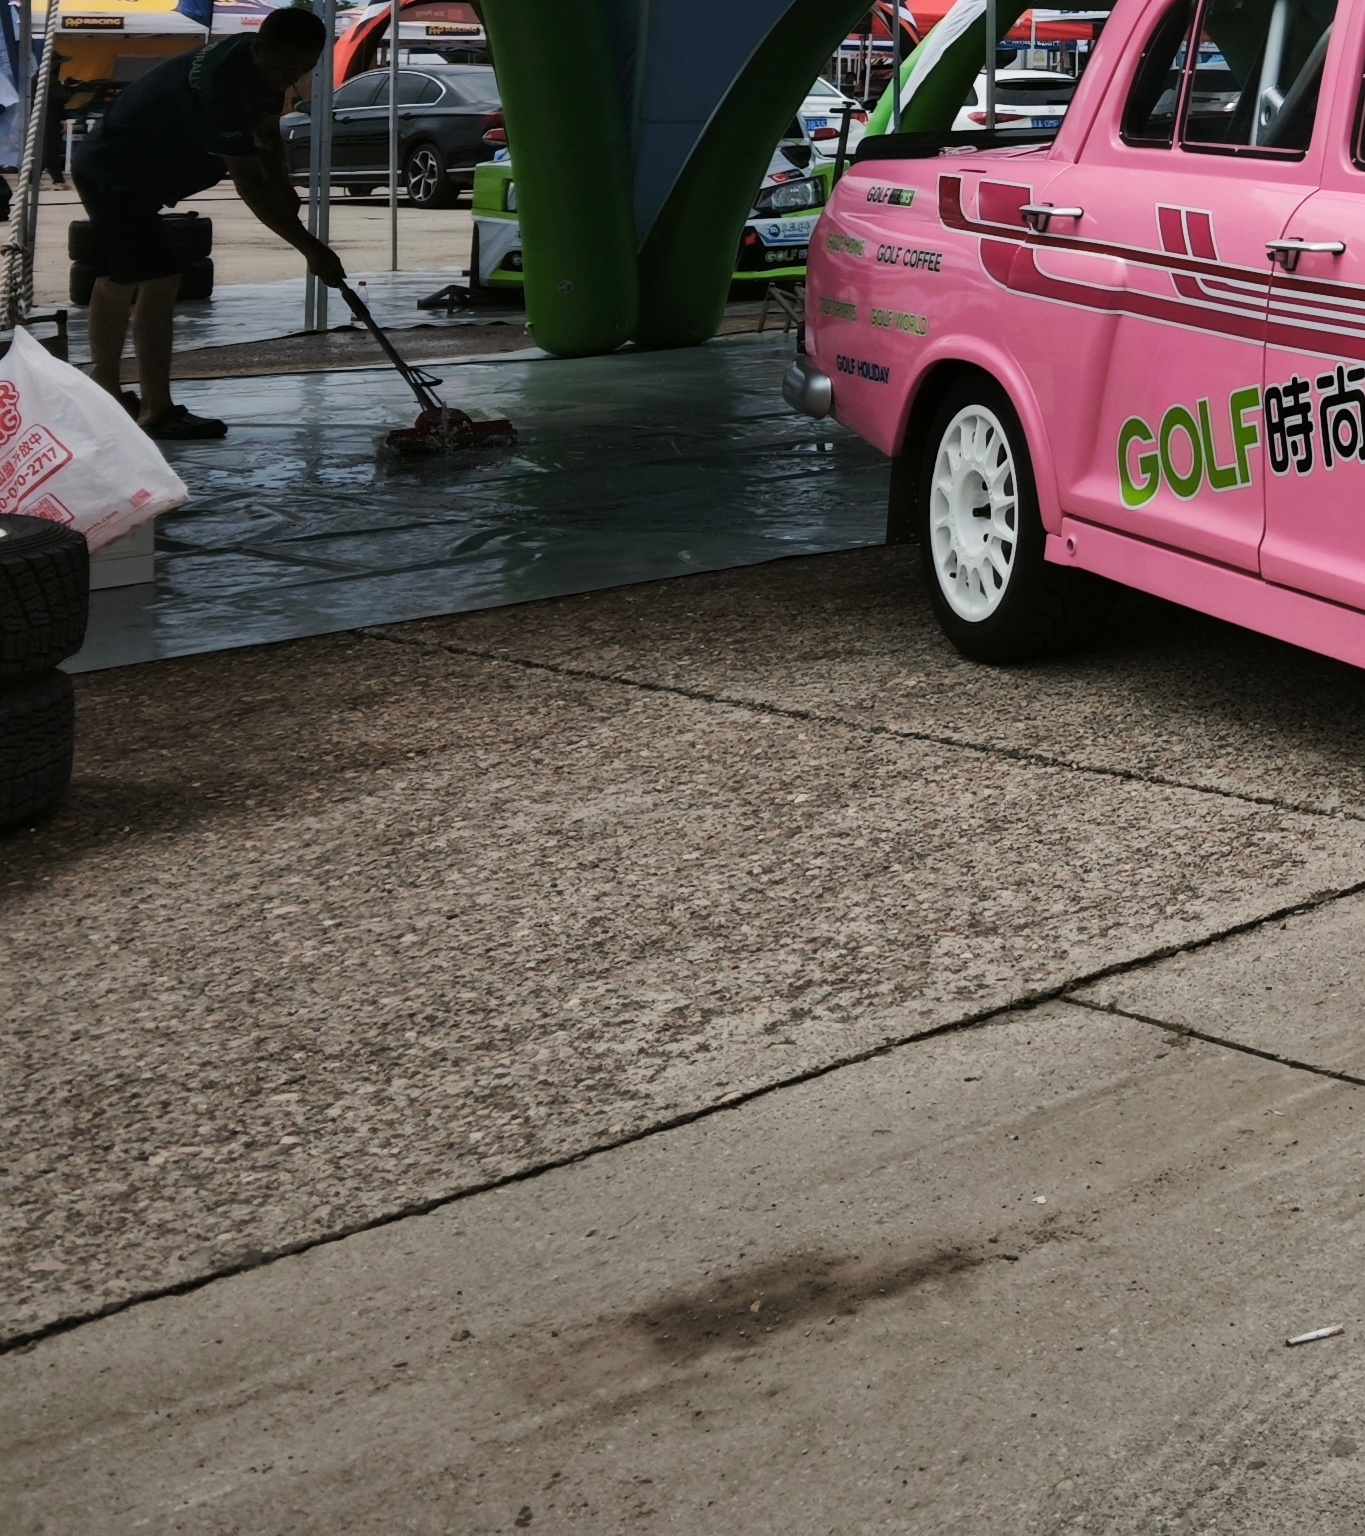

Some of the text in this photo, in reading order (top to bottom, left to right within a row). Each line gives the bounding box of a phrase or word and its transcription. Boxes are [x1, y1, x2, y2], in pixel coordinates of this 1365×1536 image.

[867, 186, 891, 204] GOLF
[877, 244, 943, 273] GOLF COFFEE
[871, 307, 928, 335] GOLF WORLD
[836, 354, 890, 384] GOLF HOLIDAY
